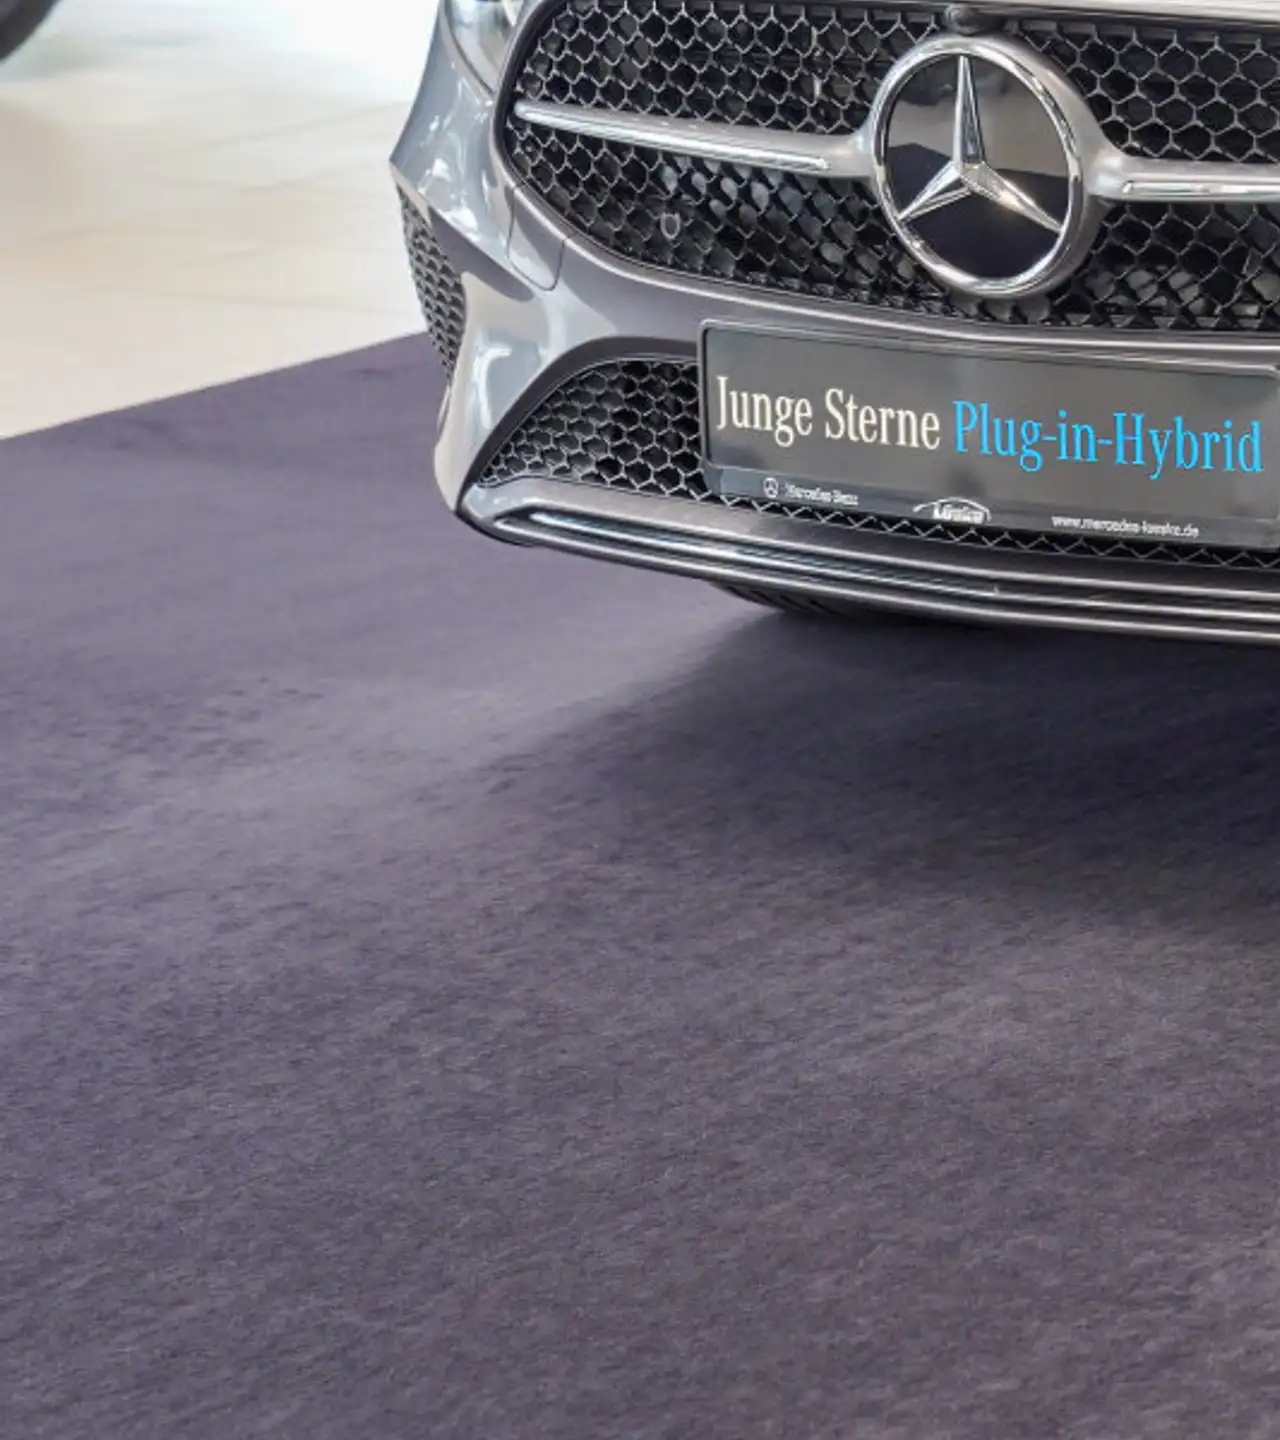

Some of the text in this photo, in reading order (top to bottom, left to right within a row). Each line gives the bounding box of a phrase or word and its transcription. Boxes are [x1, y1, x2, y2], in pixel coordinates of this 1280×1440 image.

[716, 375, 1264, 479] Junge Sterne Plug-in-Hybrid
